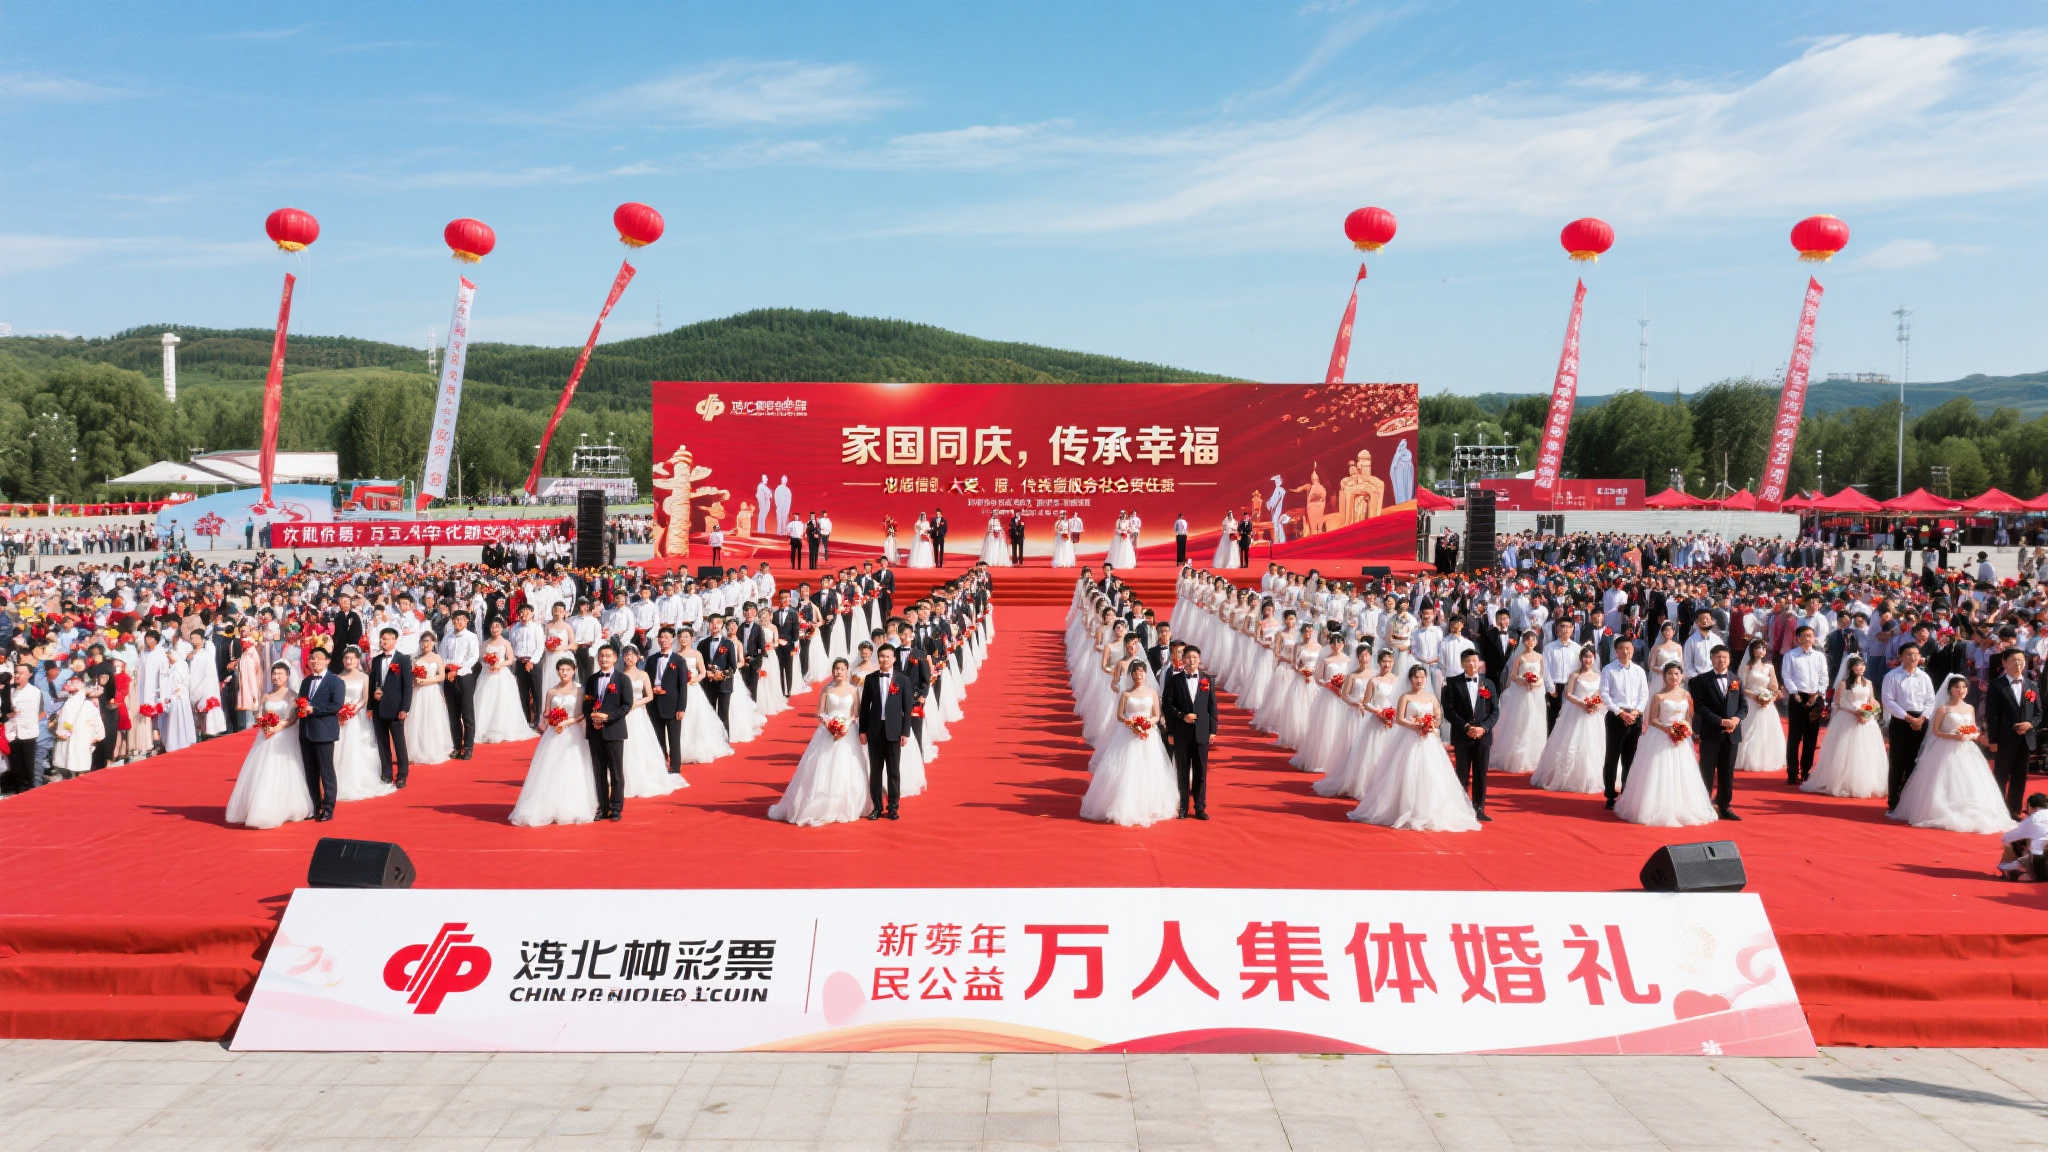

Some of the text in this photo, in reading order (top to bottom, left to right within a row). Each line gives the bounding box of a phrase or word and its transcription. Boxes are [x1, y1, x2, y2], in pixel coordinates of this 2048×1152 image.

[871, 966, 1004, 1001] 民公益
[1024, 920, 1661, 1006] 万人集体婚礼
